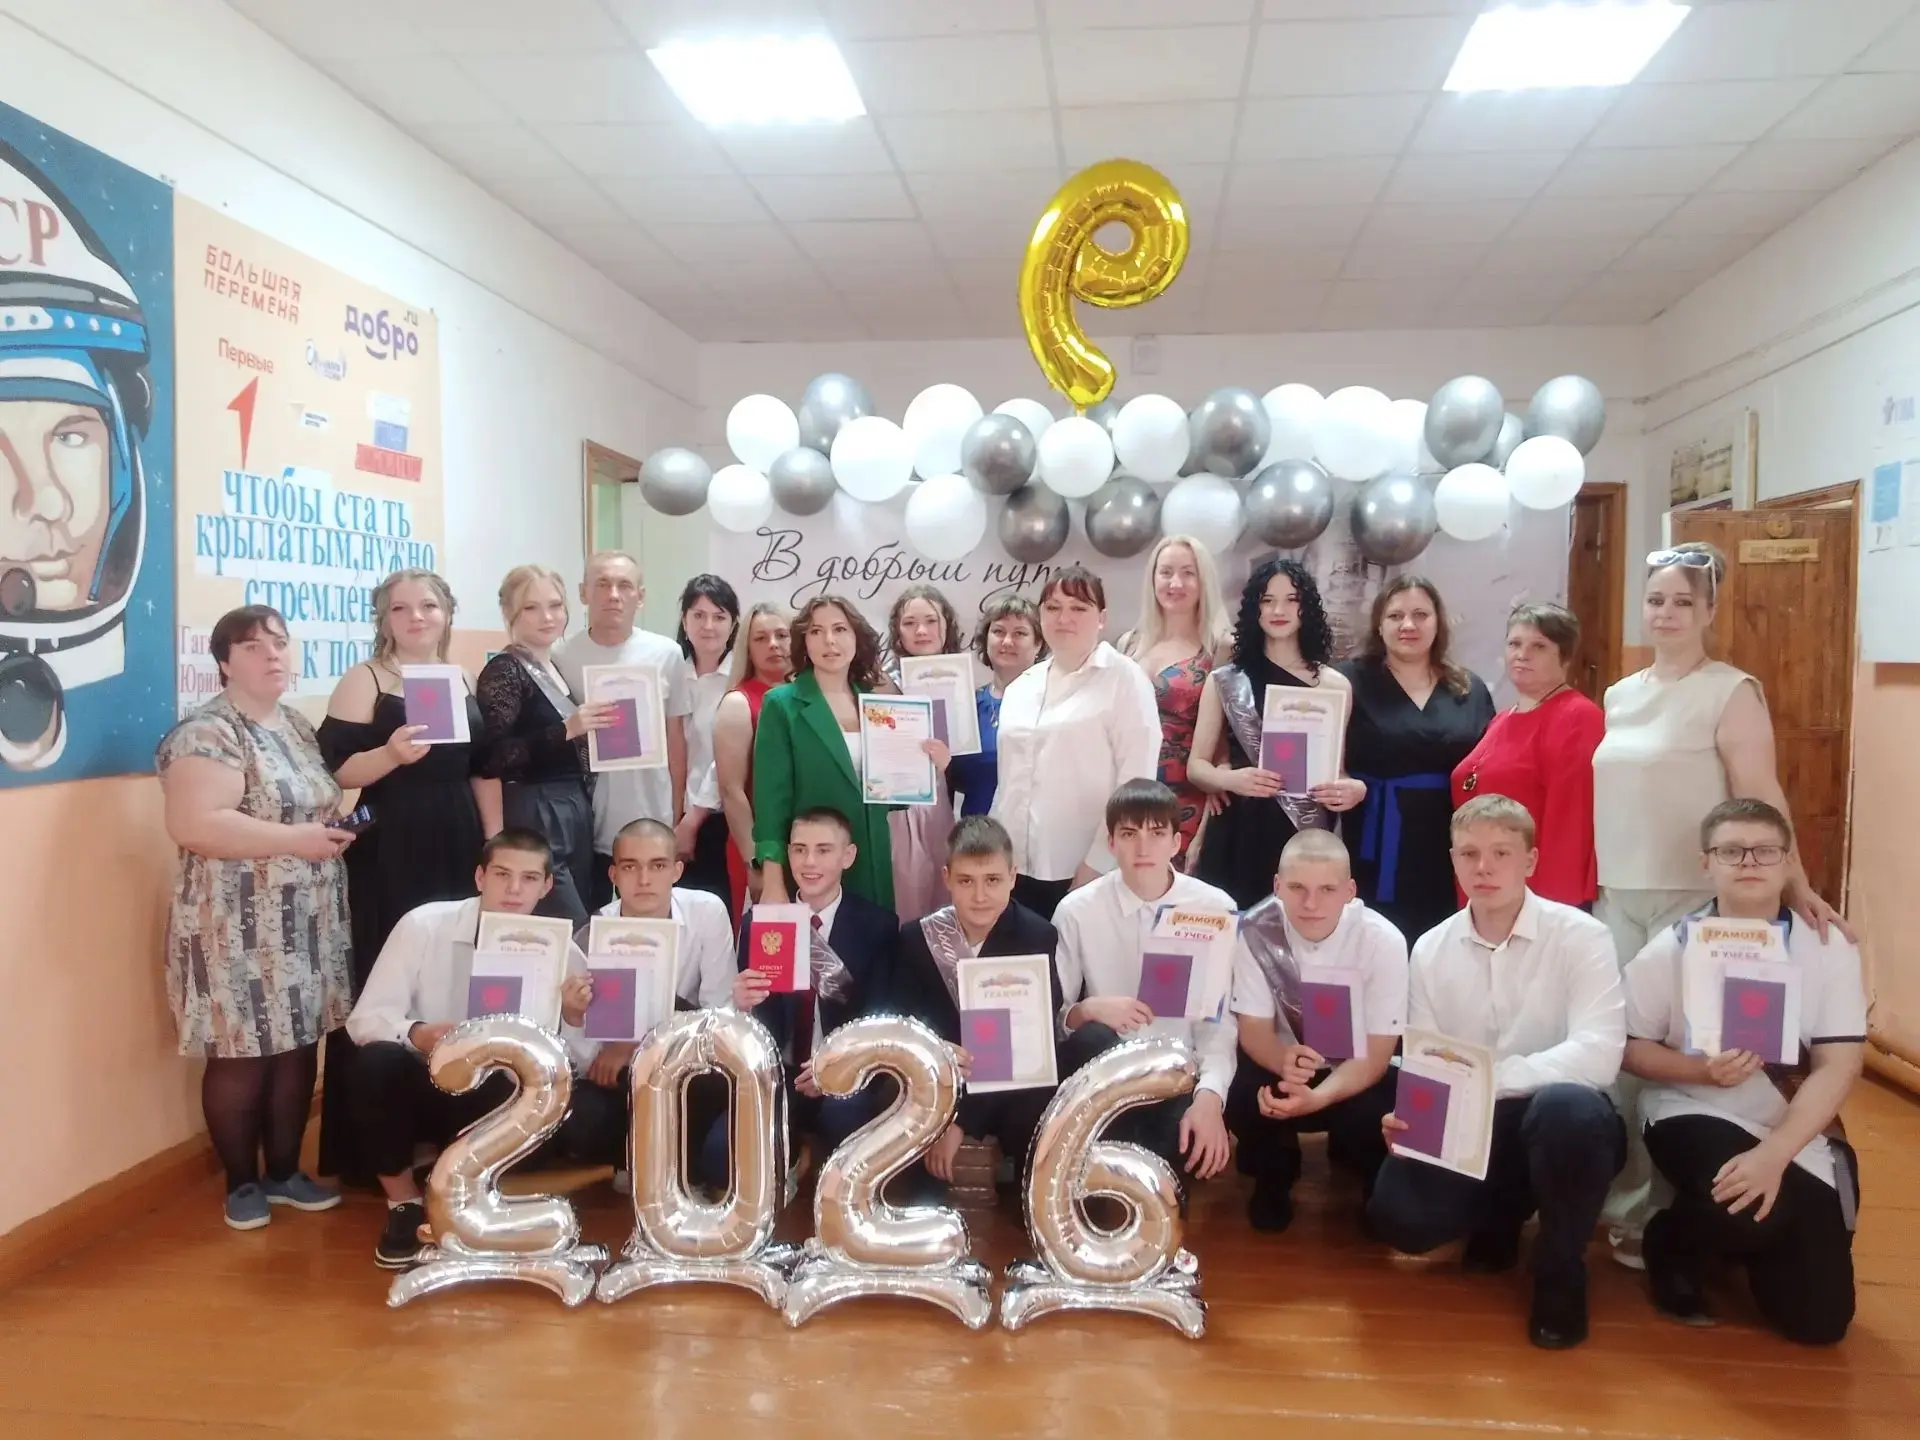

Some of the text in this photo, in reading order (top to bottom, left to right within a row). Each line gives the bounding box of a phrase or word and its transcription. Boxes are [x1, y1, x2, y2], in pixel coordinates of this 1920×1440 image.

[203, 268, 300, 326] ПЕРЕМЕНА
[205, 243, 302, 303] БОЛЬШАЯ
[218, 336, 274, 374] Первые
[344, 304, 419, 361] добро
[223, 466, 324, 526] чтобы
[750, 526, 803, 584] В
[979, 560, 1080, 614] пут
[244, 578, 375, 623] стремлен
[1177, 913, 1223, 925] ГРАМОТА
[1184, 932, 1216, 941] УЧЕБЕ
[1707, 928, 1767, 940] ГРАМОТА
[428, 1008, 1200, 1287] 2026
